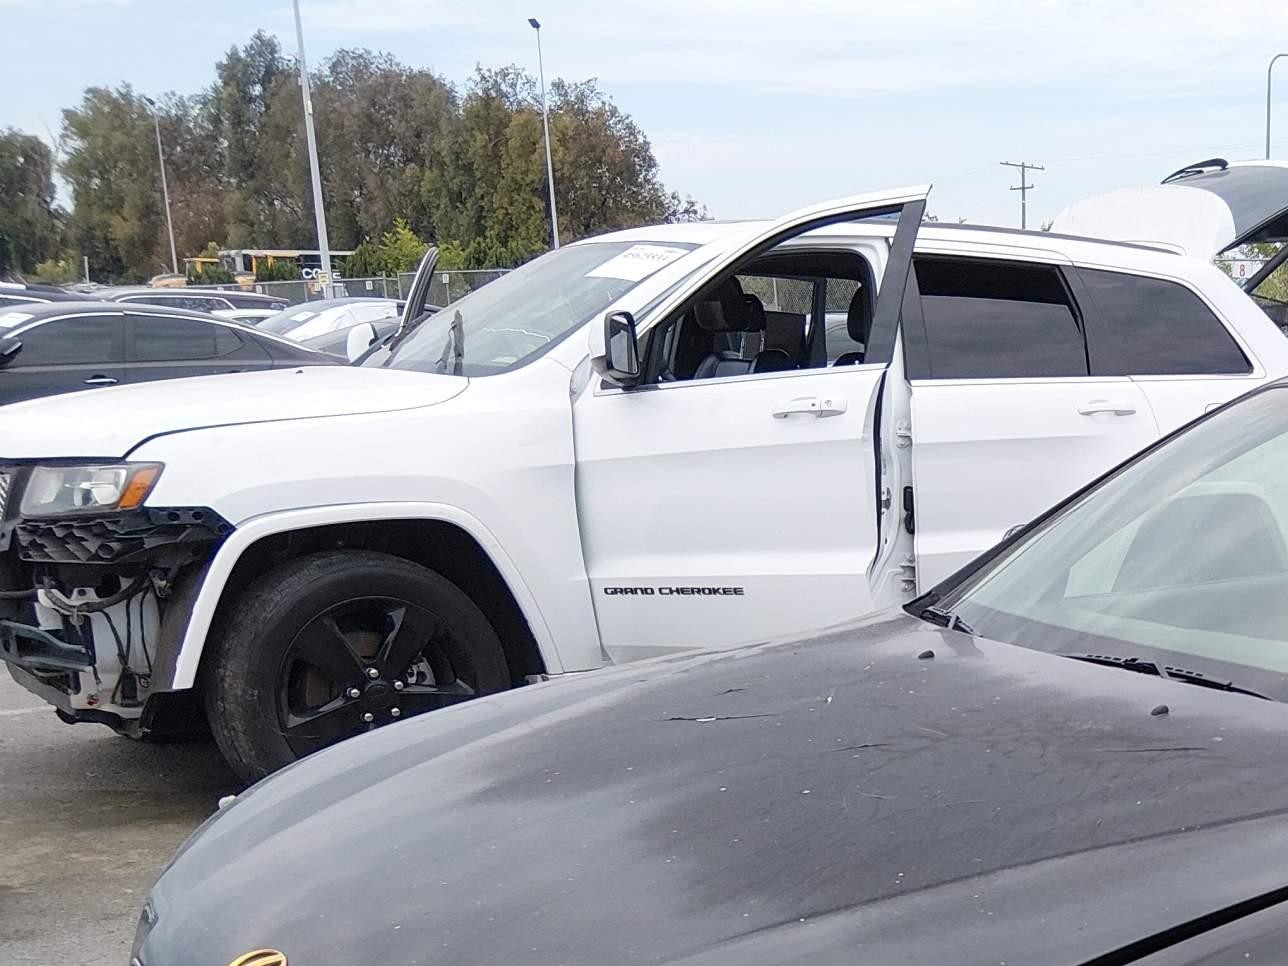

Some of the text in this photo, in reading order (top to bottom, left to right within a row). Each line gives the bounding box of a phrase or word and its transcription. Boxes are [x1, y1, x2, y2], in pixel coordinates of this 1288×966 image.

[1238, 264, 1246, 277] 8
[604, 587, 745, 596] GRAND CHEROKEE
